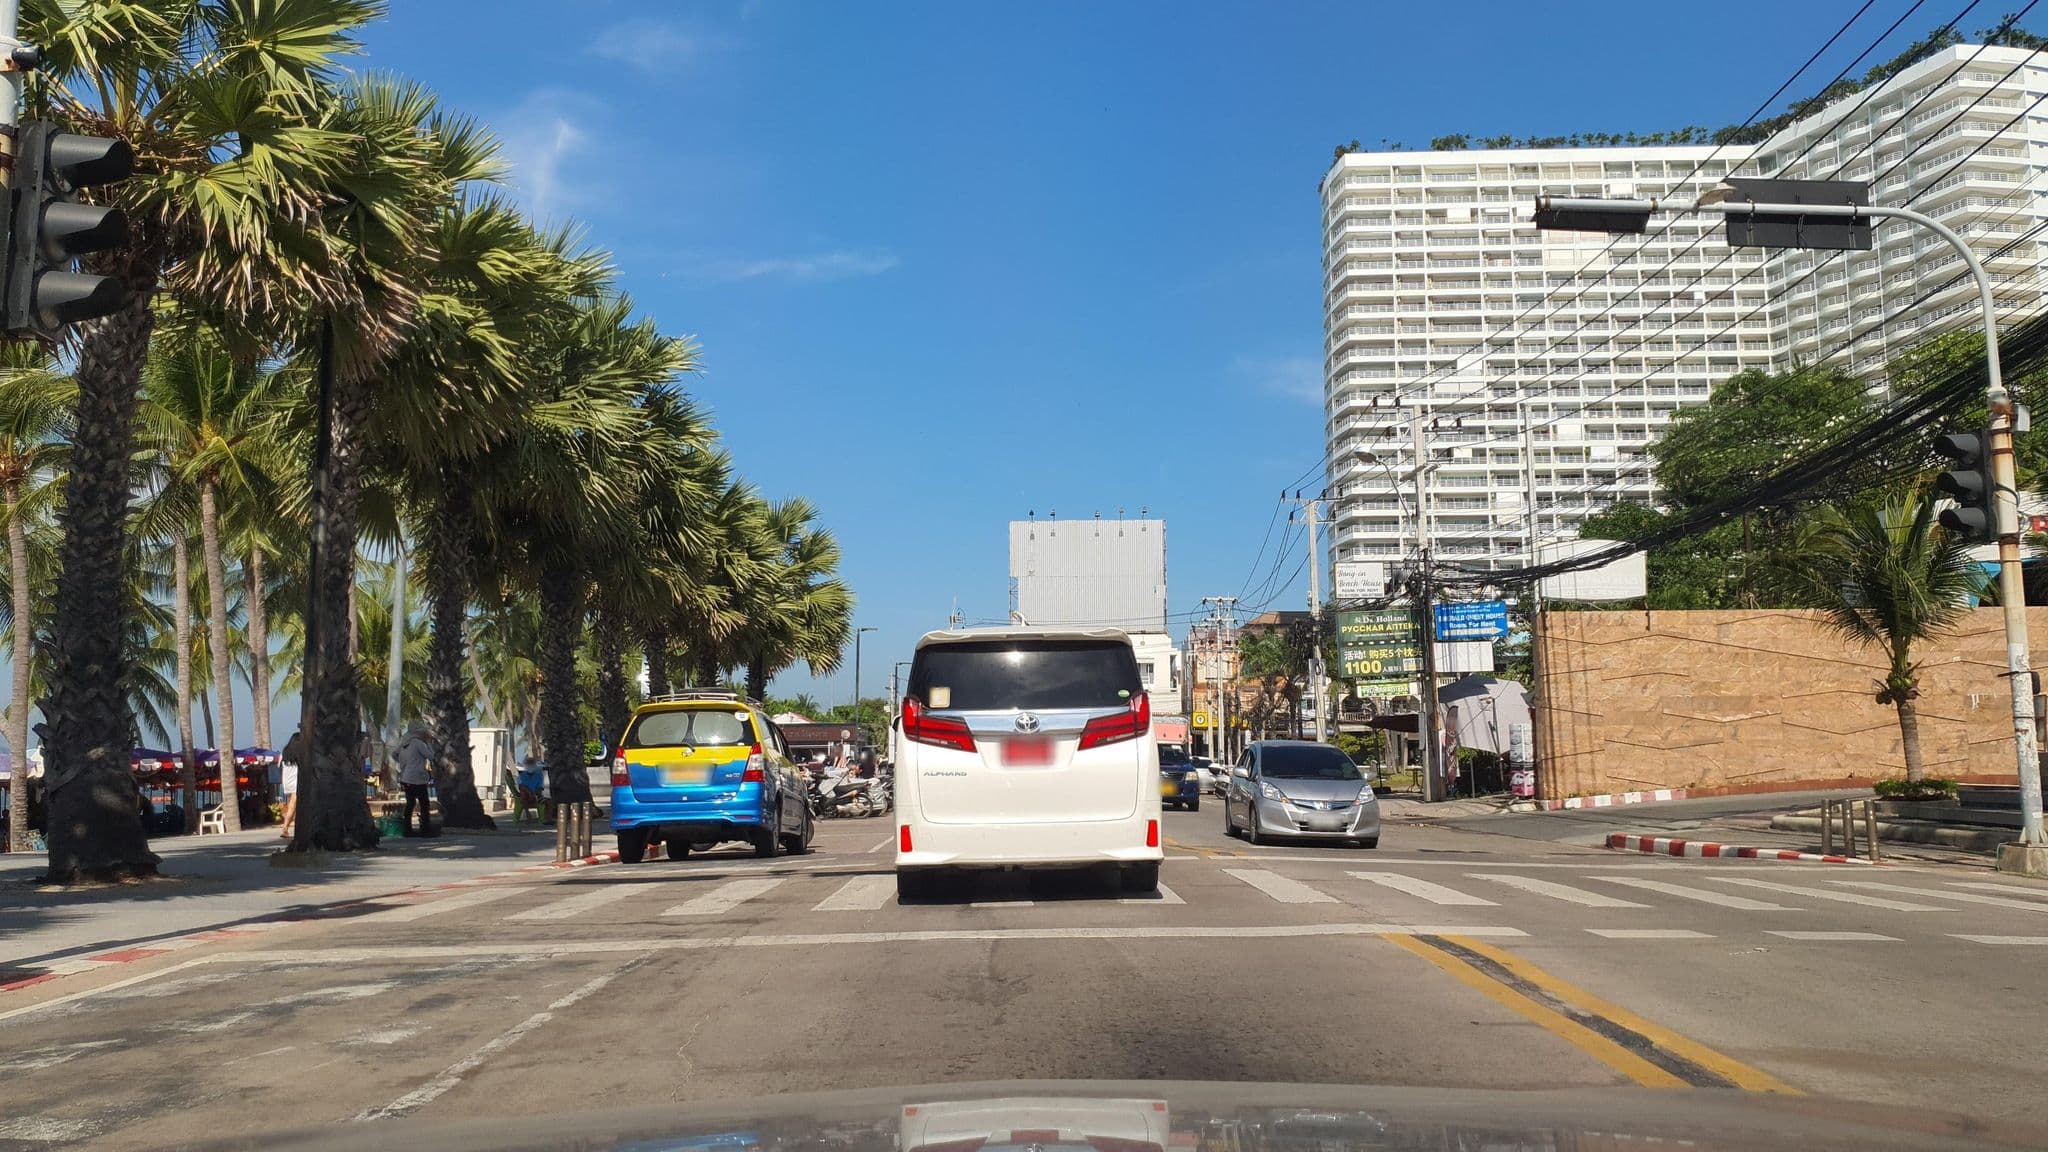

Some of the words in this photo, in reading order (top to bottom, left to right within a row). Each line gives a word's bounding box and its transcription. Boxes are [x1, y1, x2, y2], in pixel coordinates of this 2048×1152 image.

[1376, 614, 1408, 623] Holland
[1341, 623, 1385, 634] РУССКАЯ
[1386, 621, 1421, 632] АПТЕКА
[1345, 660, 1382, 675] 1100
